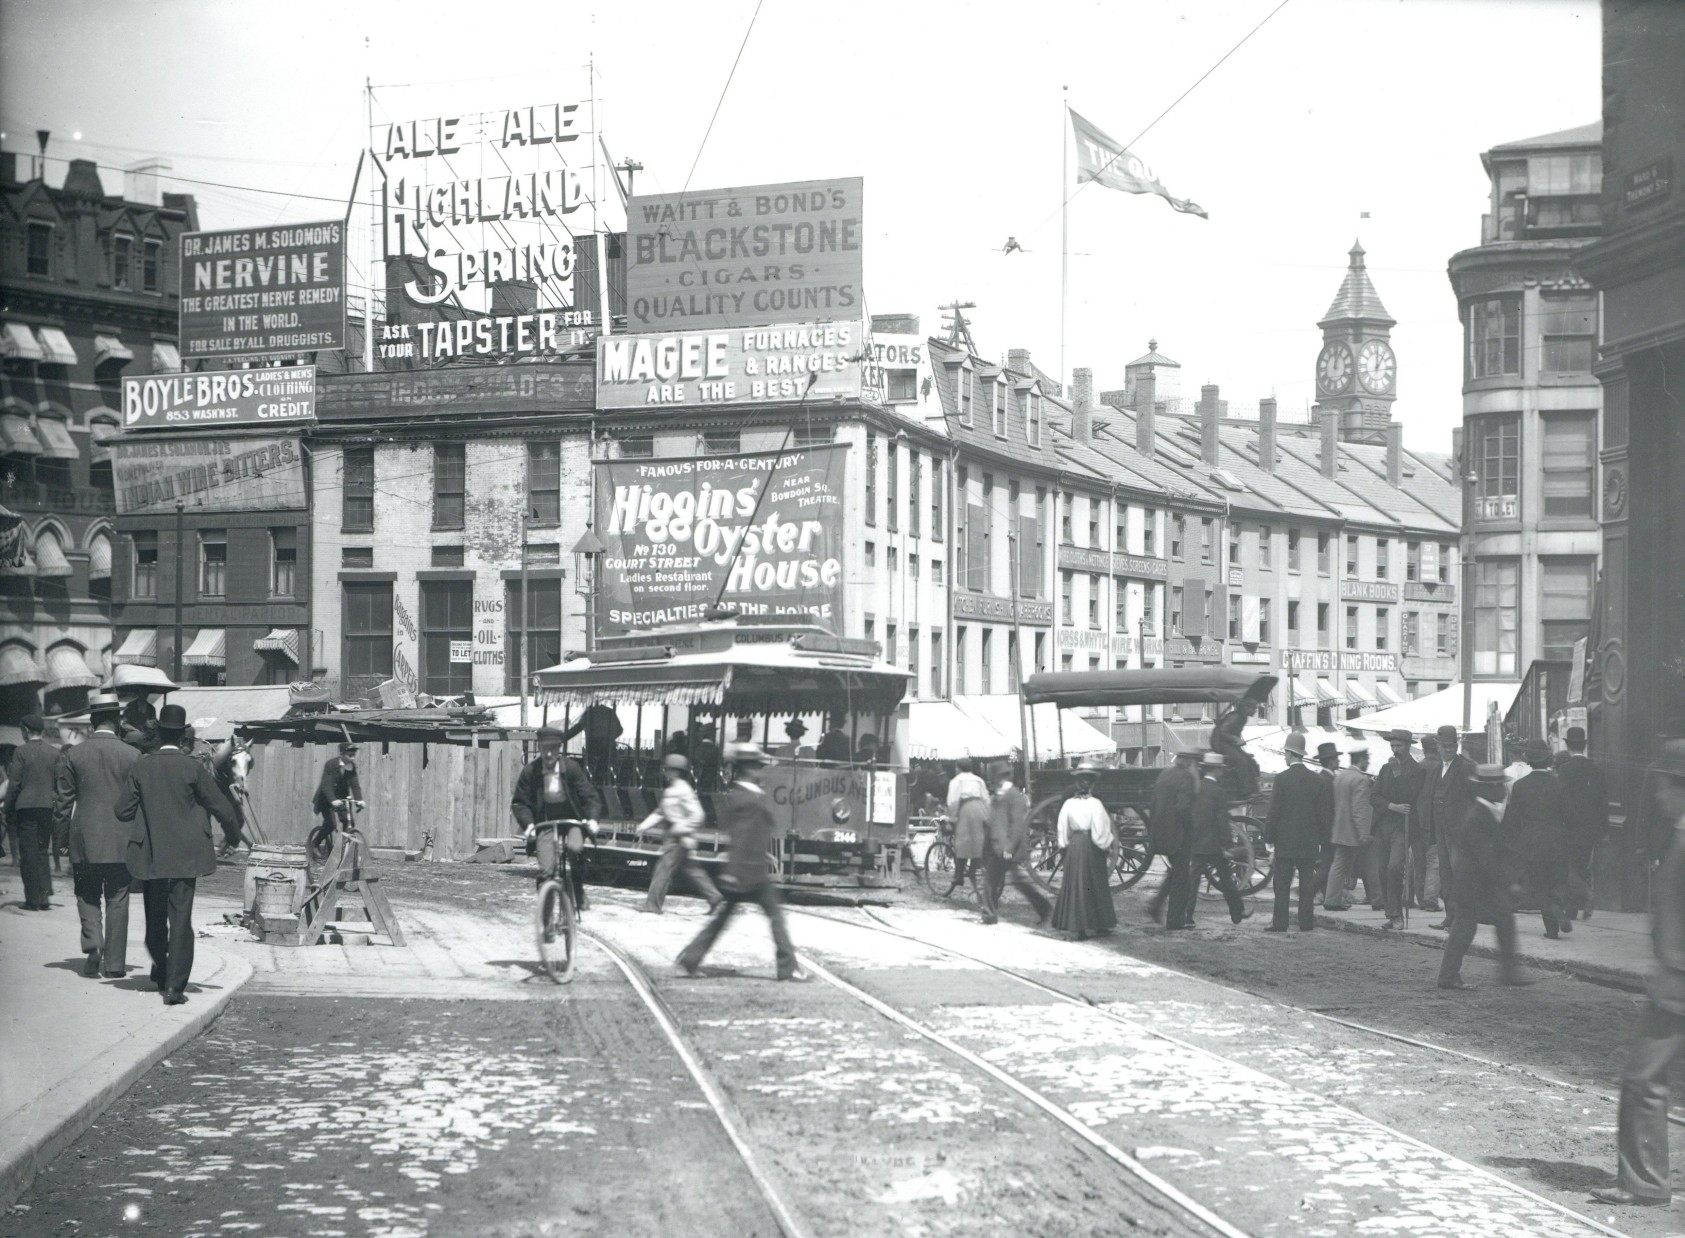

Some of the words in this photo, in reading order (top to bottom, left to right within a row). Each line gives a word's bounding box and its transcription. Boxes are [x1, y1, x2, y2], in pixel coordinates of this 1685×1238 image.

[386, 117, 460, 161] ALE
[502, 103, 579, 148] ALE
[1084, 139, 1125, 178] THE
[382, 168, 585, 256] HIGHLAND
[642, 200, 719, 223] WAITT
[727, 197, 742, 217] &
[756, 188, 846, 216] BOND'S
[205, 233, 250, 255] JAMES
[272, 224, 340, 248] SOLOMON'S
[636, 218, 859, 264] BLACKSTONE
[194, 252, 329, 291] NERVINE
[404, 241, 577, 306] SPRING
[679, 264, 805, 286] CIGARS
[183, 297, 201, 313] THE
[204, 294, 259, 312] GREATEST
[261, 291, 295, 308] NERVE
[299, 287, 340, 305] REMEDY
[633, 292, 746, 324] QUALITY
[753, 284, 855, 311] COUNTS
[223, 317, 236, 332] IN
[238, 316, 258, 331] THE
[263, 313, 302, 329] WORLD.
[565, 311, 591, 326] FOR
[190, 339, 208, 352] FOR
[209, 338, 232, 351] SALE
[233, 337, 246, 349] BY
[247, 335, 265, 348] ALL
[269, 332, 336, 348] DRUGGISTS.
[383, 325, 409, 339] ASK
[417, 313, 557, 358] TAPSTER
[742, 326, 851, 352] FURNACES
[379, 343, 413, 358] YOUR
[601, 334, 729, 385] MAGEE
[745, 357, 758, 376] &
[765, 352, 850, 375] RANGES
[284, 371, 290, 380] &
[291, 369, 313, 380] MEN'S
[259, 380, 313, 397] CLOTHING
[647, 384, 685, 404] ARE
[699, 382, 735, 400] THE
[752, 377, 807, 398] BEST
[126, 378, 193, 425] BOYLE
[197, 374, 259, 407] BROS.
[257, 401, 312, 418] CREDIT.
[166, 411, 189, 421] 853
[640, 463, 692, 477] FAMOUS
[696, 460, 720, 472] FOR
[724, 460, 735, 470] A
[783, 475, 811, 488] NEAR
[771, 486, 811, 502] BOWDOIN
[798, 495, 841, 508] THEATRE.
[694, 511, 823, 566] Oyster
[651, 544, 677, 556] 130
[649, 557, 702, 568] STREET
[620, 572, 652, 583] Ladies
[655, 571, 713, 582] Restaurant
[725, 553, 842, 593] House
[648, 583, 682, 592] second
[684, 582, 709, 592] floor.
[1342, 583, 1368, 599] BLANK
[1369, 584, 1397, 600] BOOKS
[609, 603, 709, 625] SPECIALTIES
[735, 633, 784, 643] COLUMBUS
[1111, 636, 1132, 654] WIRE
[473, 651, 504, 665] CLOTHS
[1332, 652, 1361, 670] DNING
[1363, 653, 1397, 671] ROOMS.
[773, 776, 846, 806] COLUMBUS
